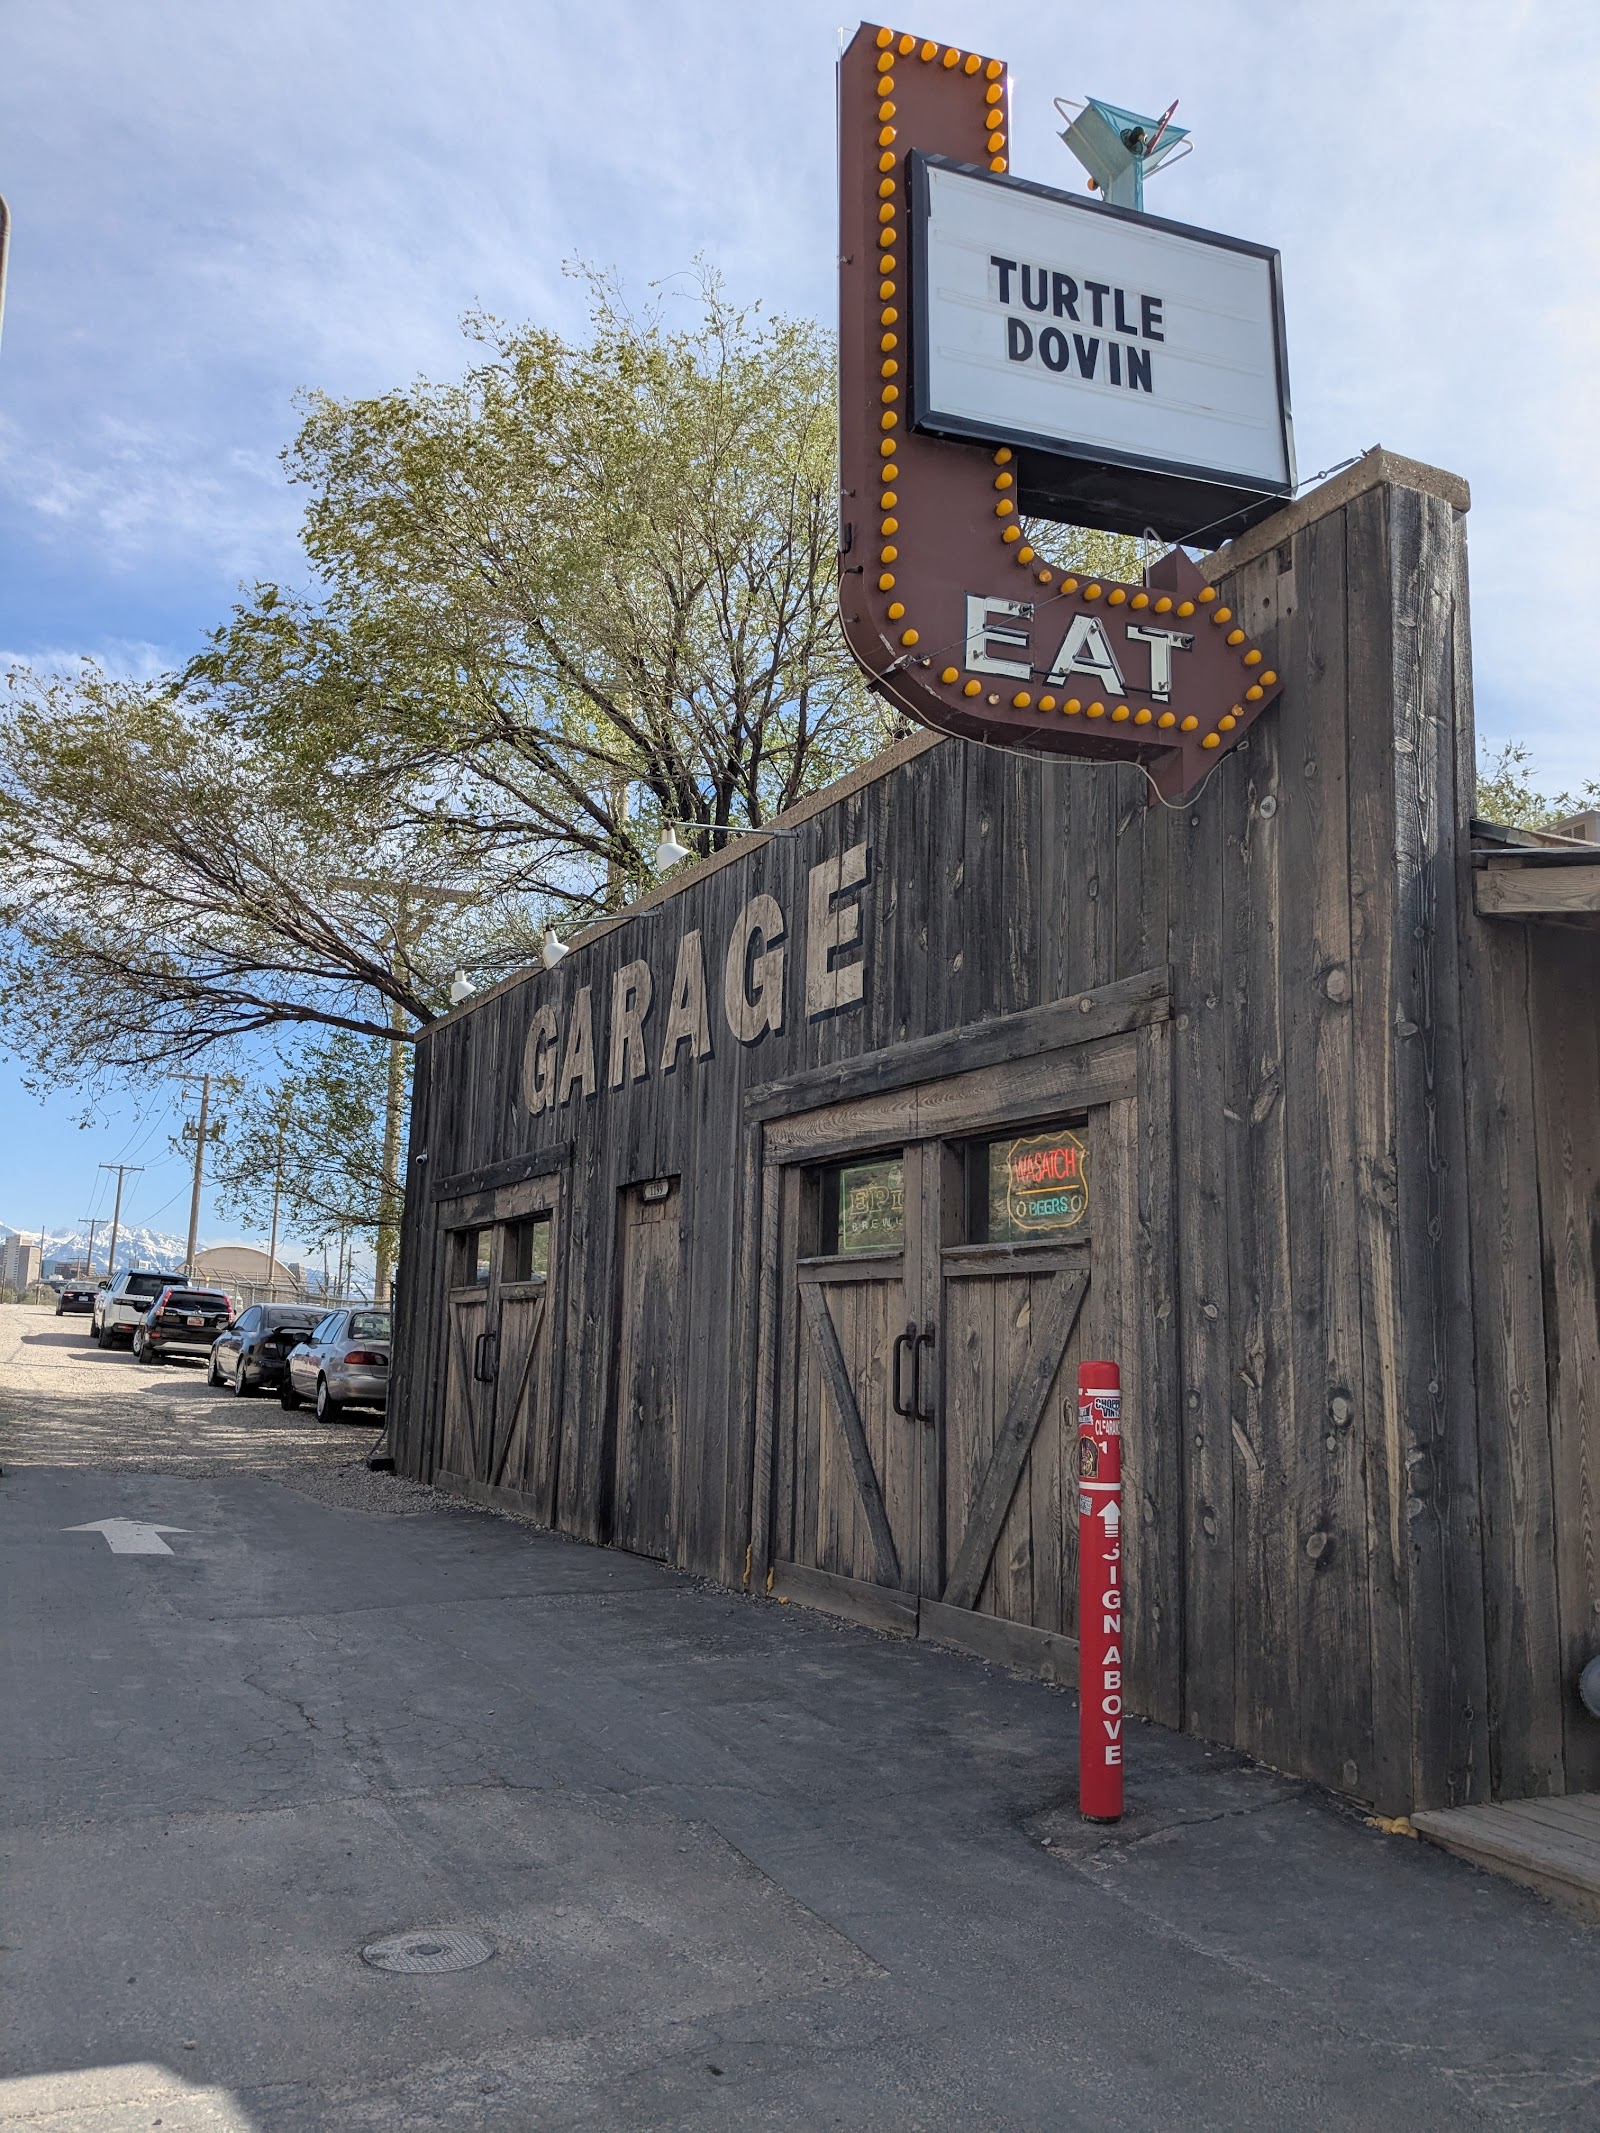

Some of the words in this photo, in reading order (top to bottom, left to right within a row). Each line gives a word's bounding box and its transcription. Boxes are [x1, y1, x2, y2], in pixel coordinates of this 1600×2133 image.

[990, 255, 1165, 342] TURTLE
[1007, 317, 1153, 393] DOVIN
[965, 594, 1195, 703] EAT
[523, 840, 873, 1117] GARAGE
[849, 1186, 904, 1215] EPI
[1014, 1147, 1077, 1183] WASATCH
[1029, 1196, 1068, 1216] BEERS
[1102, 1646, 1121, 1765] ABOVE
